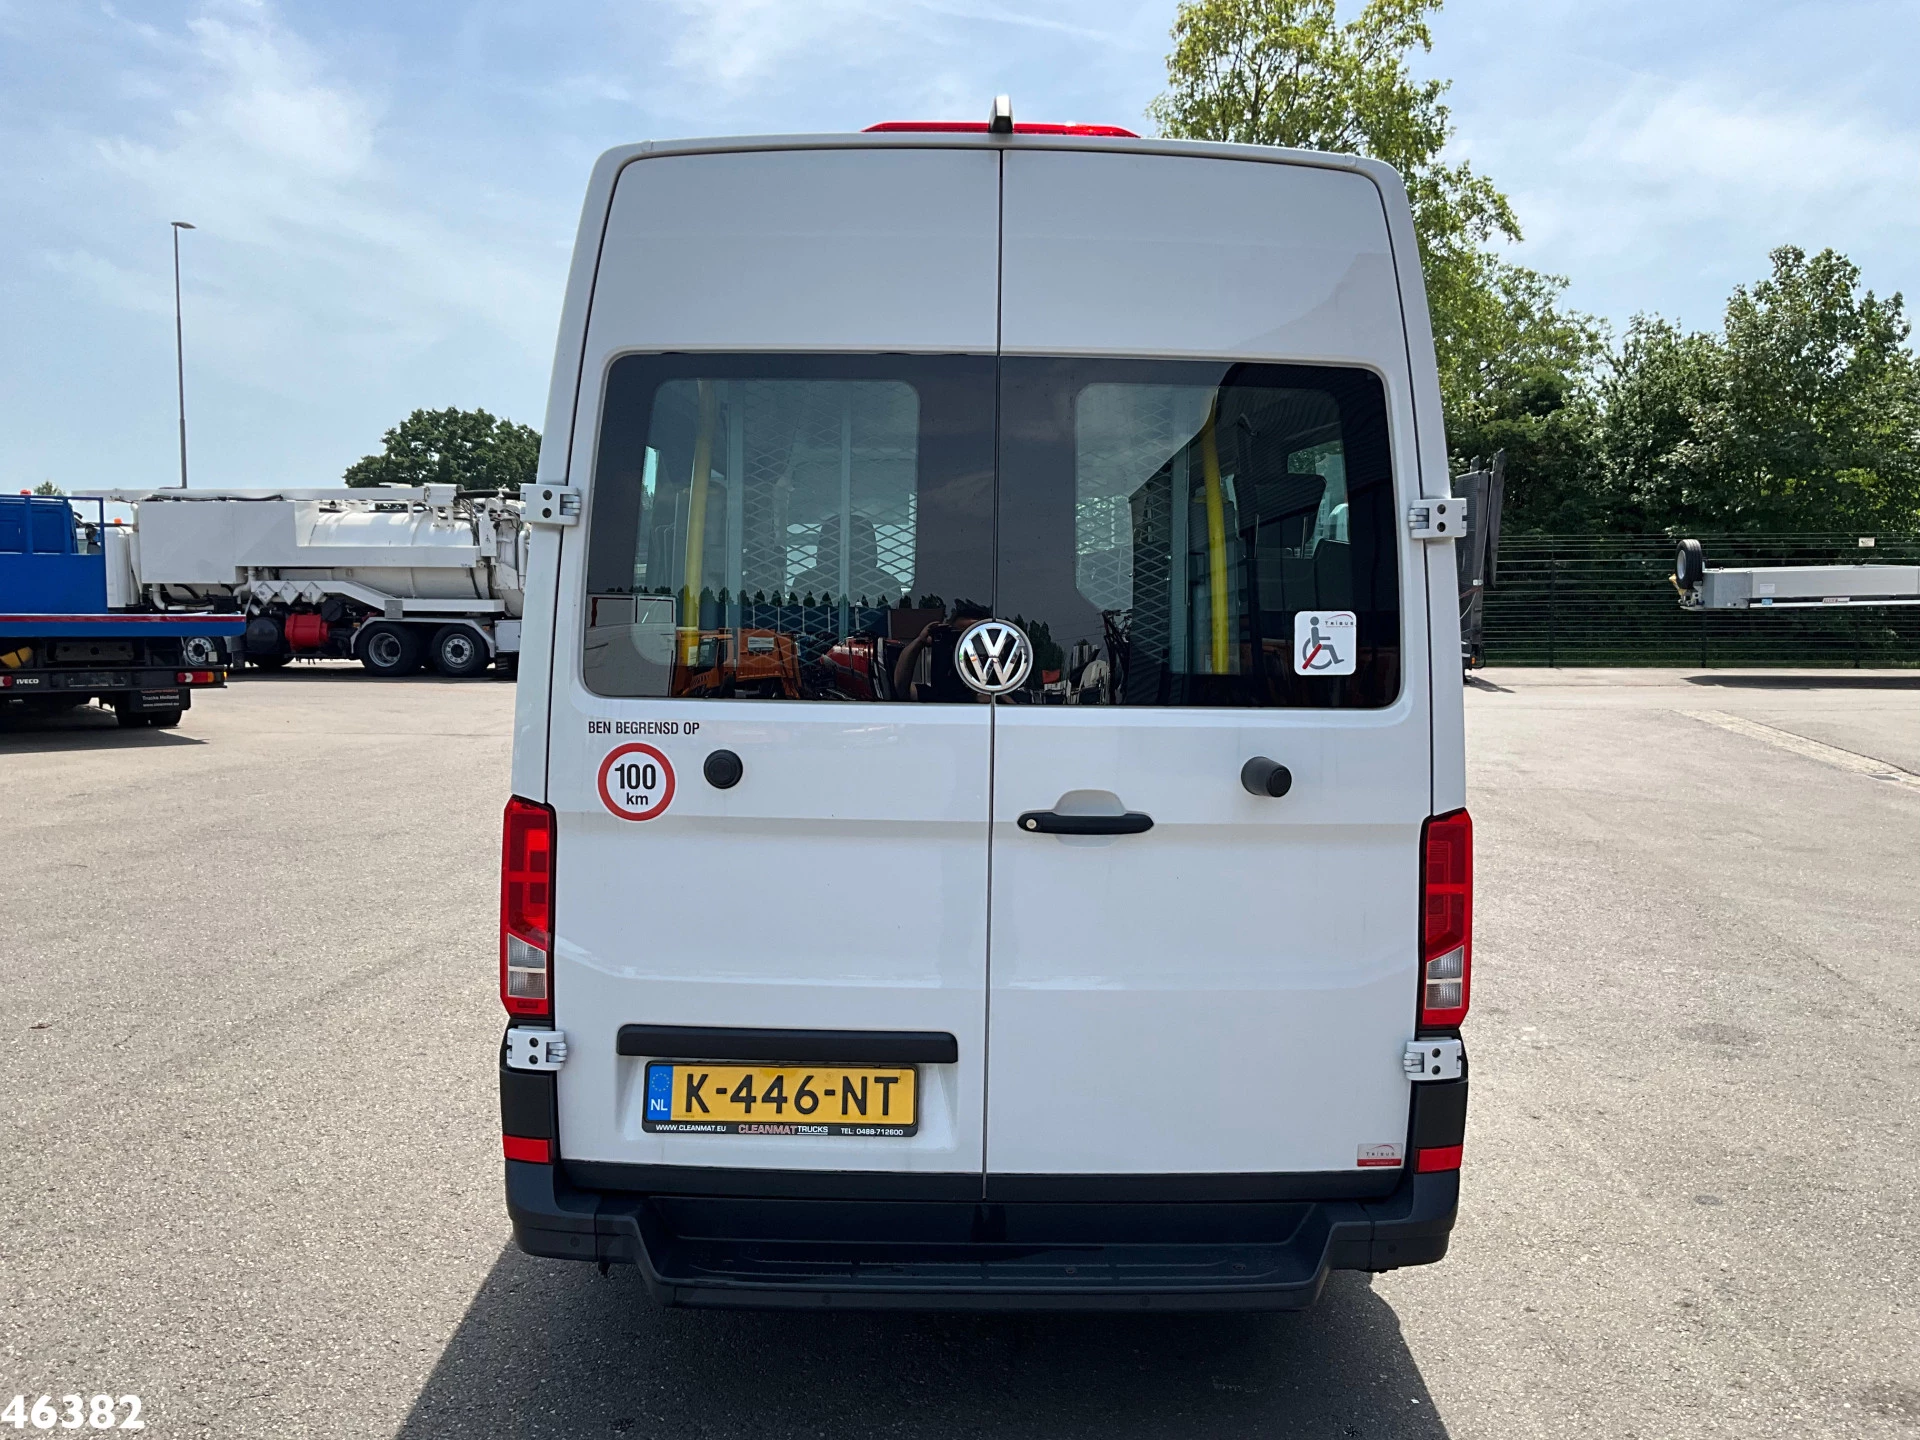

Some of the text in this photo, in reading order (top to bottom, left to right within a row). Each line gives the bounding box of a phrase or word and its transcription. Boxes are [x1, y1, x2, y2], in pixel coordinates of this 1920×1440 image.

[588, 721, 700, 735] BEN BEGRENSD OP
[614, 763, 657, 790] 100
[626, 792, 649, 805] km
[685, 1073, 899, 1116] K-446-NT
[650, 1098, 669, 1111] NL
[655, 1123, 727, 1133] WWW.CLEANMAT.EU
